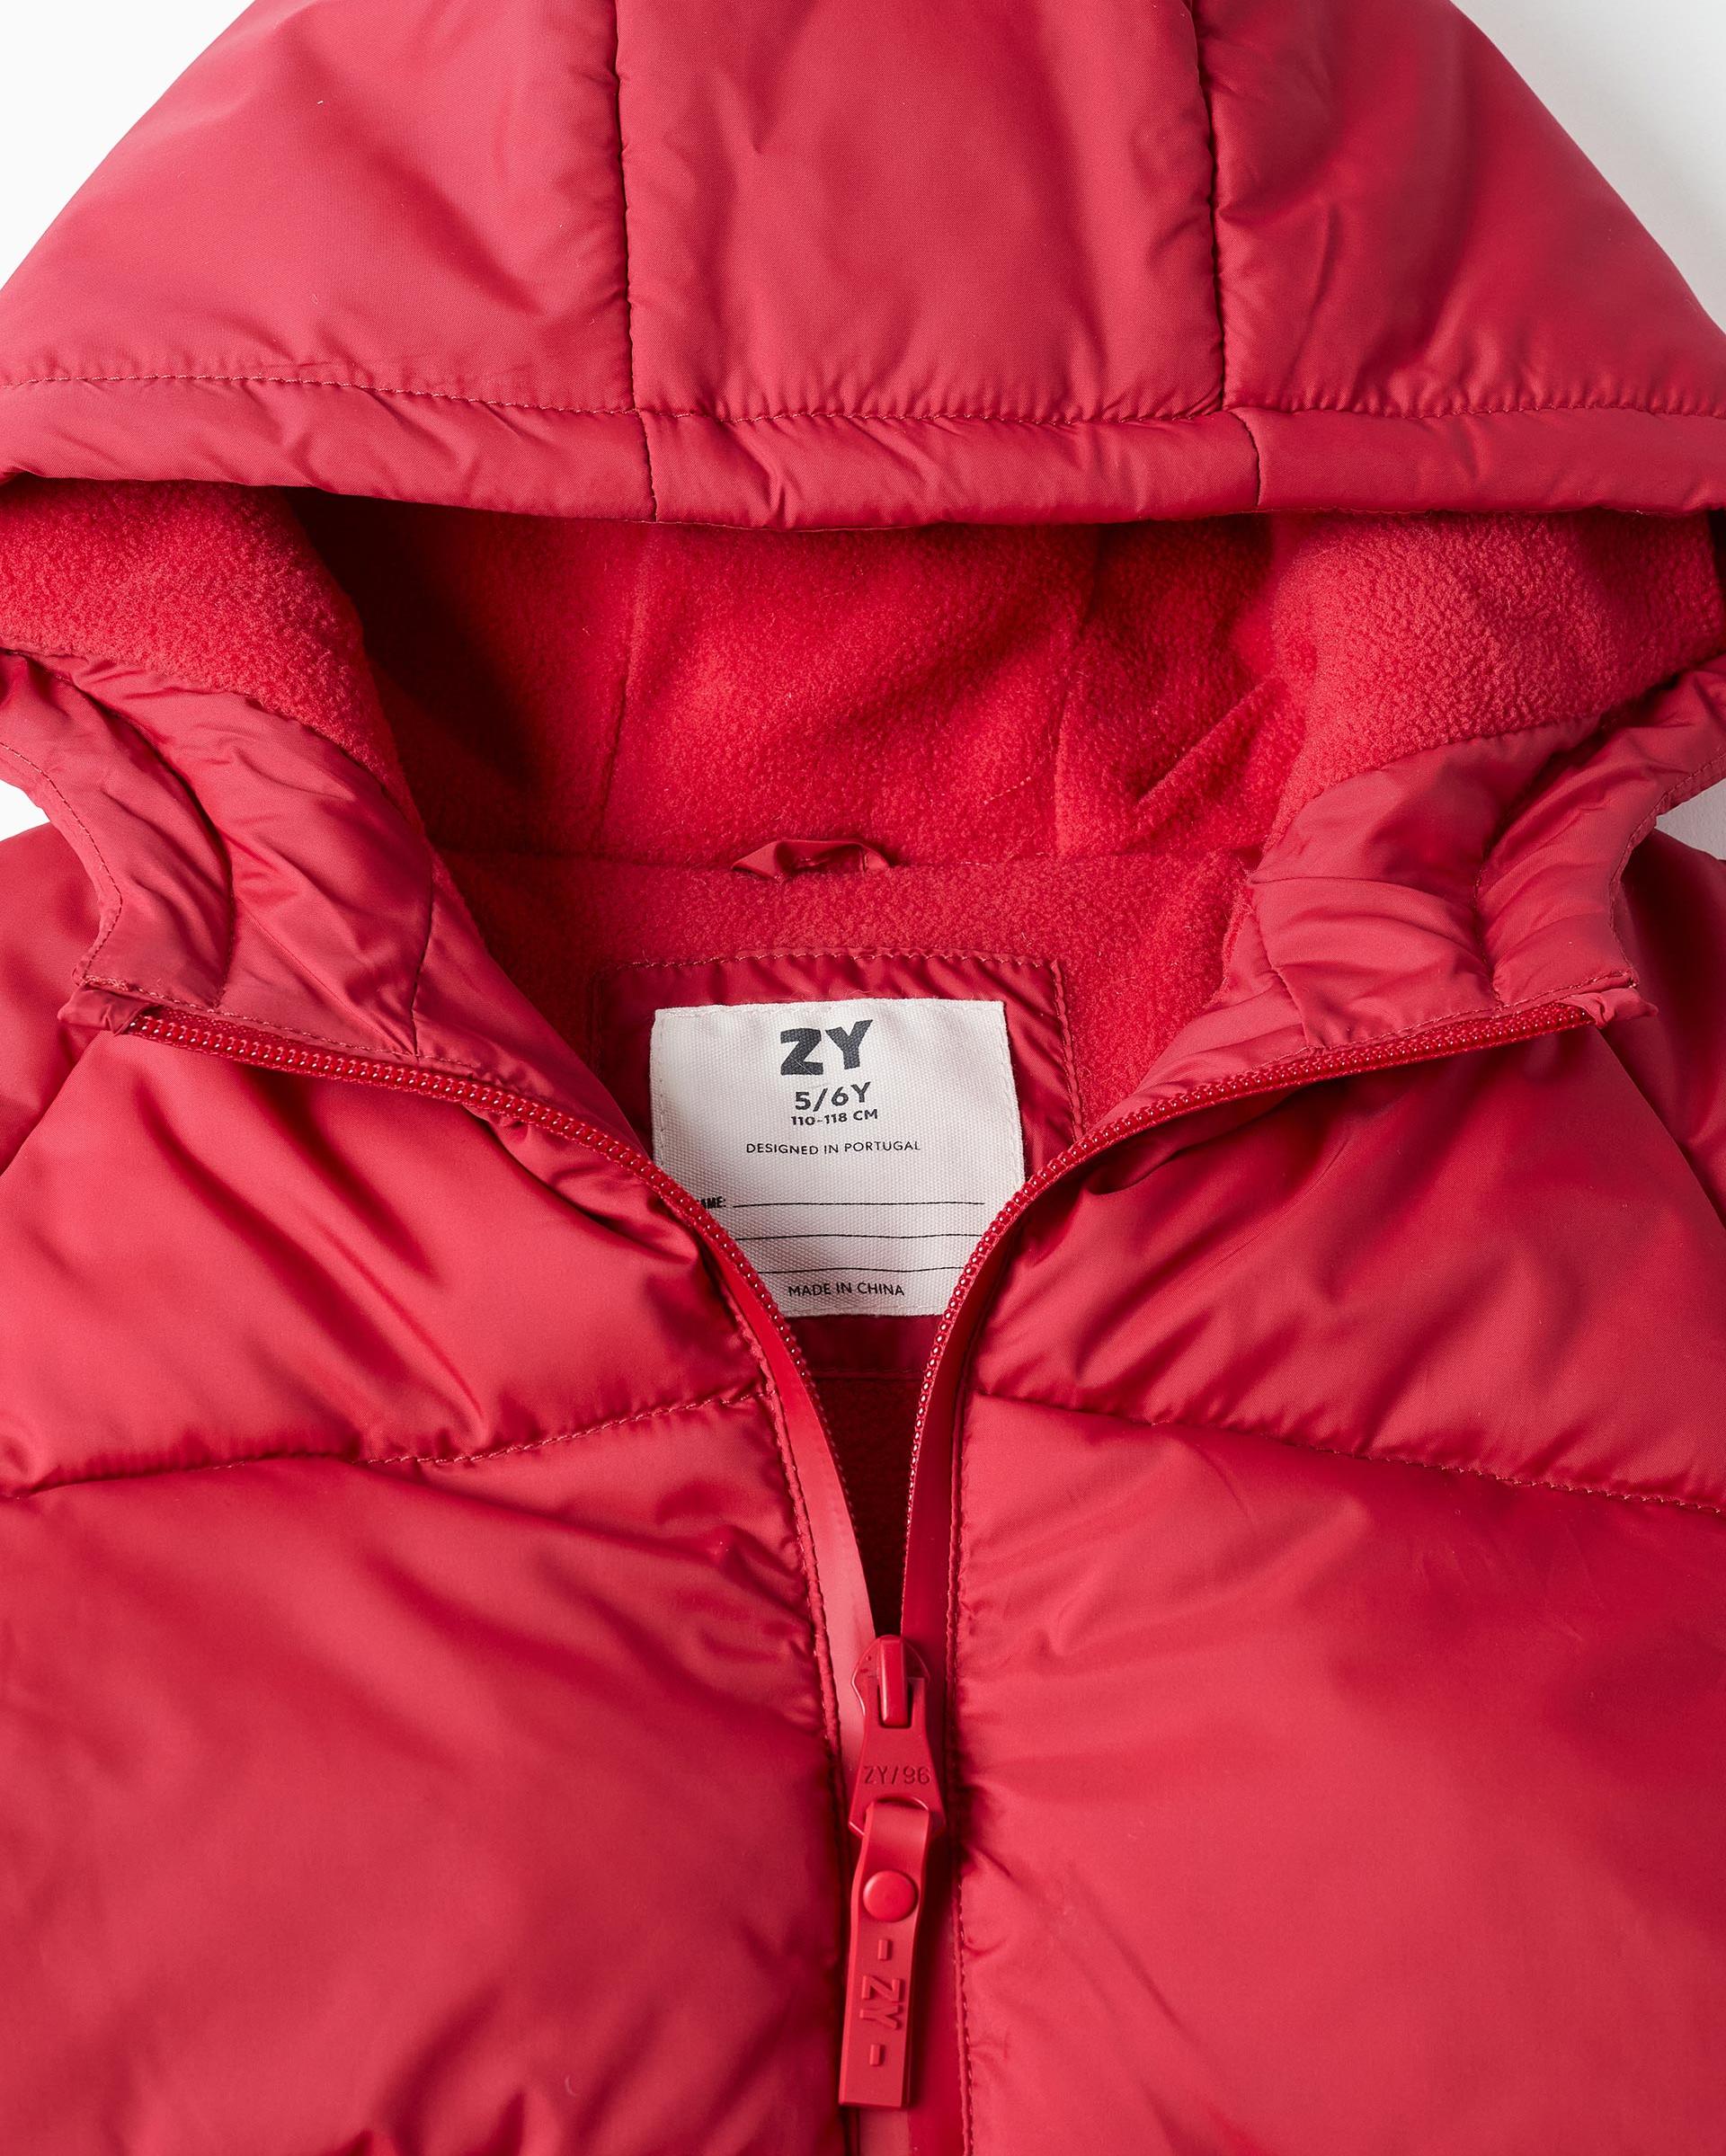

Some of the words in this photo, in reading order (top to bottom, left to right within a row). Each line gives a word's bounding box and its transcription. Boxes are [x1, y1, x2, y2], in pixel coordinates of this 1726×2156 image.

[780, 1019, 873, 1076] ZY
[795, 1082, 871, 1112] 5/6Y
[791, 1113, 848, 1125] 110-118
[853, 1109, 877, 1121] CM
[746, 1143, 818, 1155] DESIGNED
[823, 1142, 839, 1154] IN
[844, 1140, 921, 1152] PORTUGAL
[697, 1196, 726, 1209] AME:
[788, 1283, 832, 1296] MADE
[836, 1282, 852, 1293] IN
[858, 1282, 904, 1296] CHINA
[864, 1765, 931, 1785] ZY/96
[860, 1974, 901, 2030] ZY
